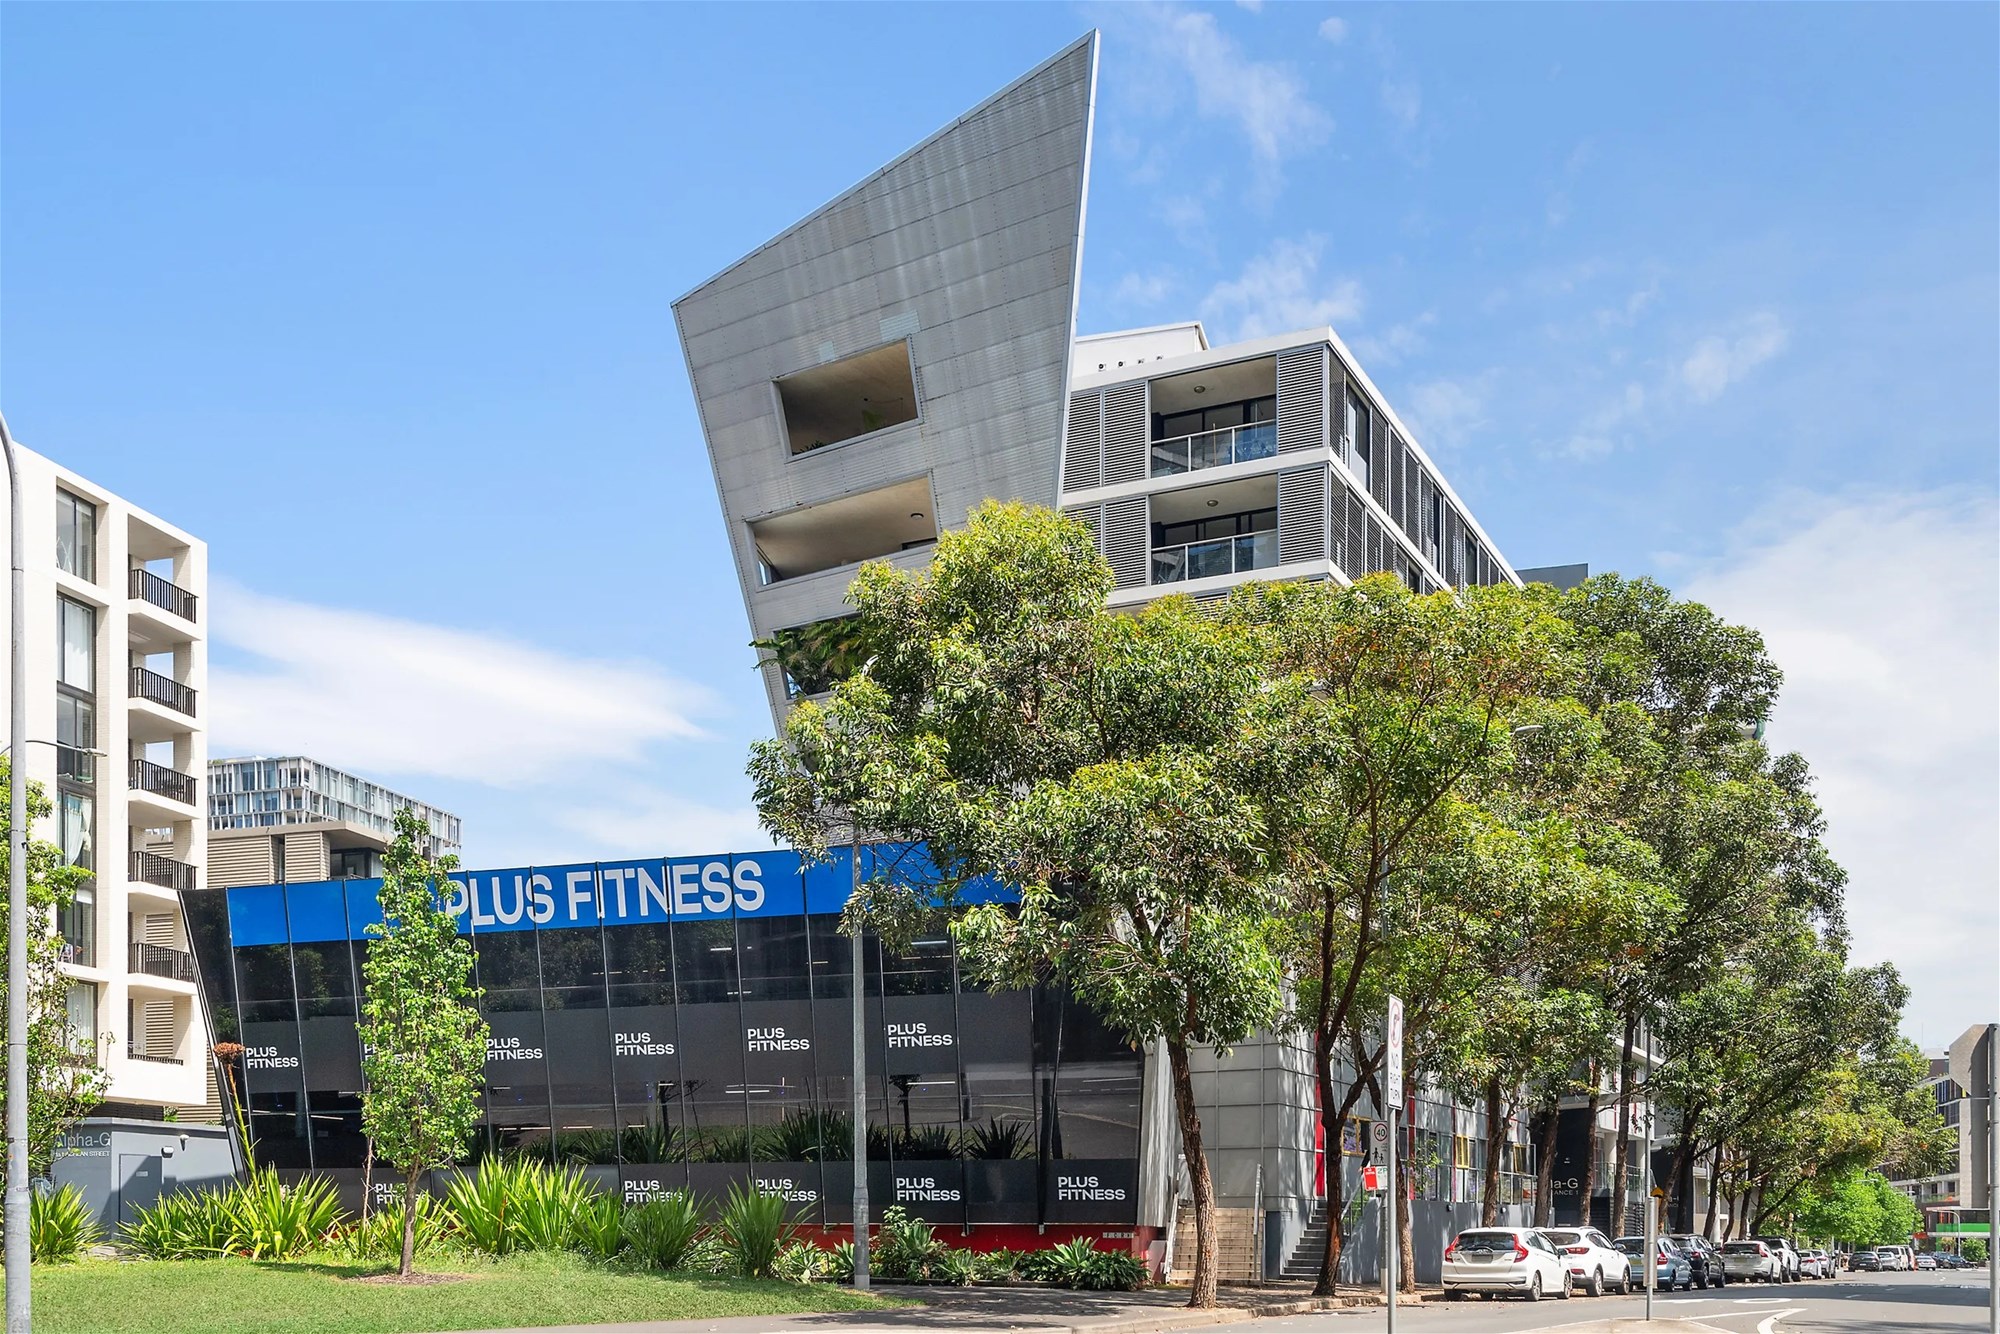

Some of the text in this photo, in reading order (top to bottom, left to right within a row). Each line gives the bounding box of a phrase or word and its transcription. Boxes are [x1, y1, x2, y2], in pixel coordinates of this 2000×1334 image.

[448, 860, 766, 927] PLUS FITNESS
[747, 1027, 785, 1039] PLUS
[887, 1023, 927, 1036] PLUS
[486, 1037, 521, 1049] PLUS
[615, 1032, 651, 1044] PLUS
[888, 1034, 953, 1048] FITNESS
[615, 1043, 675, 1056] FITNESS
[748, 1039, 810, 1052] FITNESS
[246, 1046, 278, 1058] PLUS
[487, 1048, 543, 1061] FITNESS
[247, 1057, 299, 1069] FITNESS
[1376, 1128, 1386, 1138] 40
[624, 1180, 661, 1191] PLUS
[755, 1178, 793, 1190] PLUS
[896, 1177, 936, 1189] PLUS
[1057, 1176, 1099, 1188] PLUS
[897, 1189, 961, 1201] FITNESS
[1058, 1188, 1126, 1201] FITNESS
